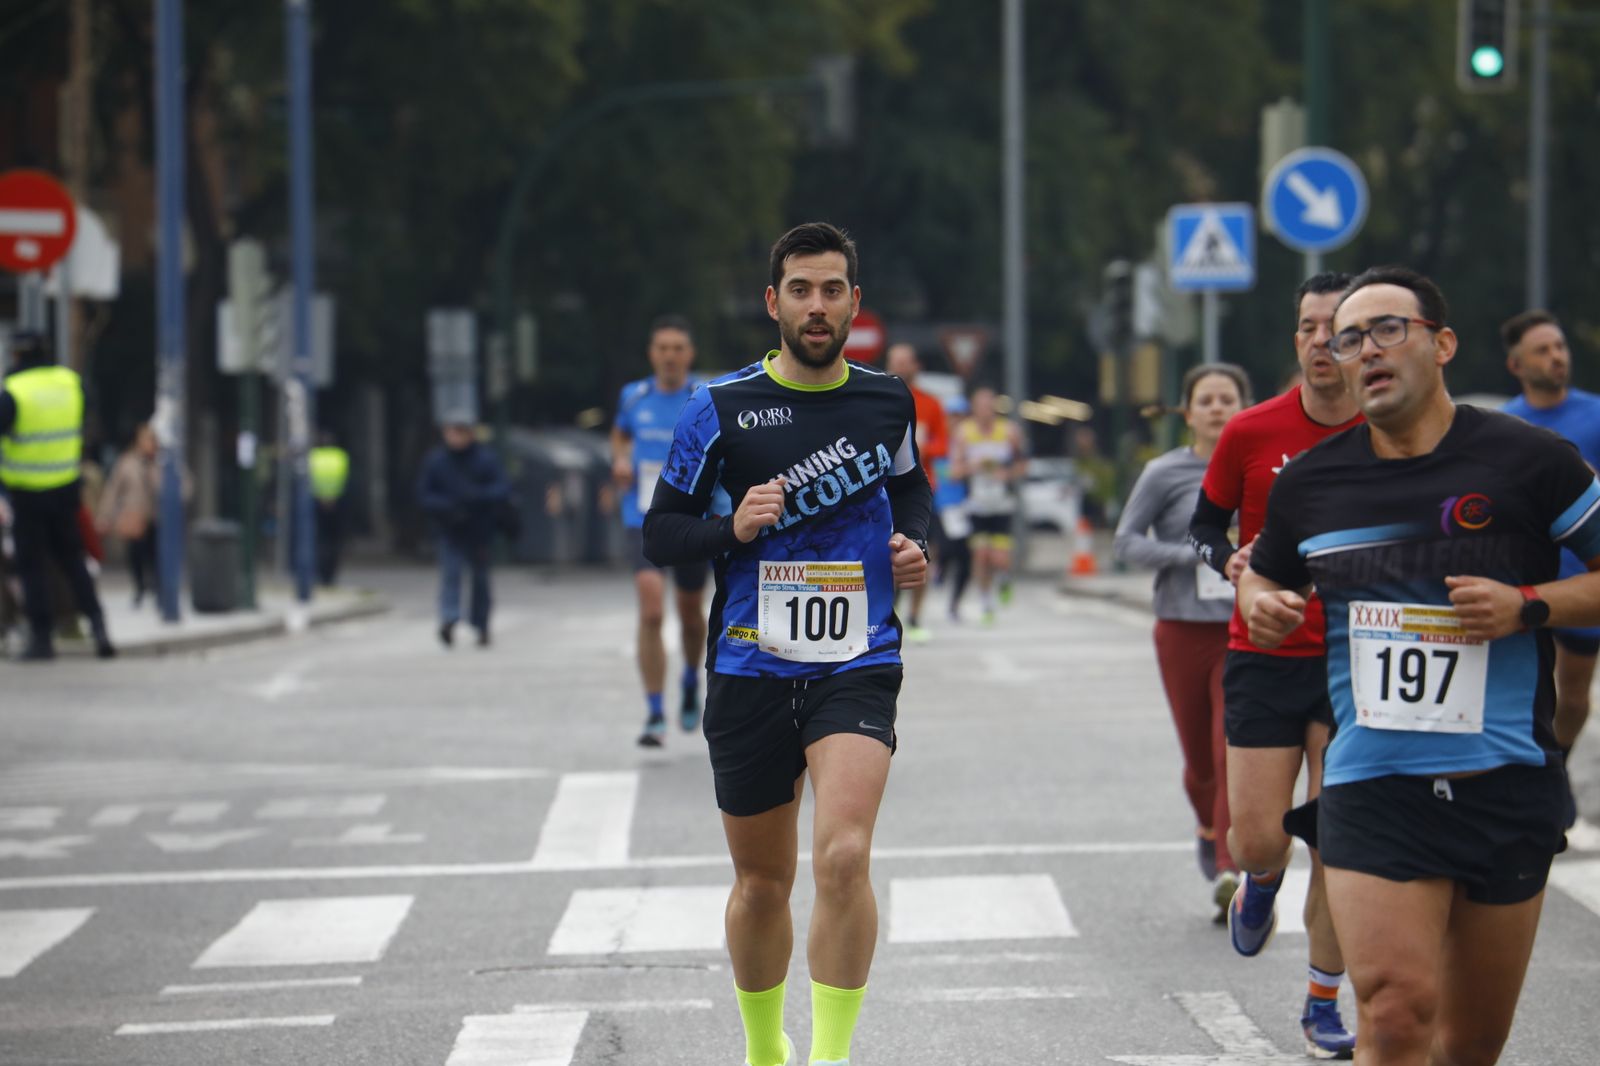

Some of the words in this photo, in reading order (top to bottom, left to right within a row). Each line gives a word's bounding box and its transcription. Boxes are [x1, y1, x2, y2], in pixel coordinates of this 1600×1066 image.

[759, 406, 792, 420] ORO
[764, 565, 805, 581] XXXIX
[786, 596, 850, 642] 100
[1354, 606, 1401, 628] XXXIX
[726, 628, 749, 639] Diego
[1376, 646, 1459, 705] 197
